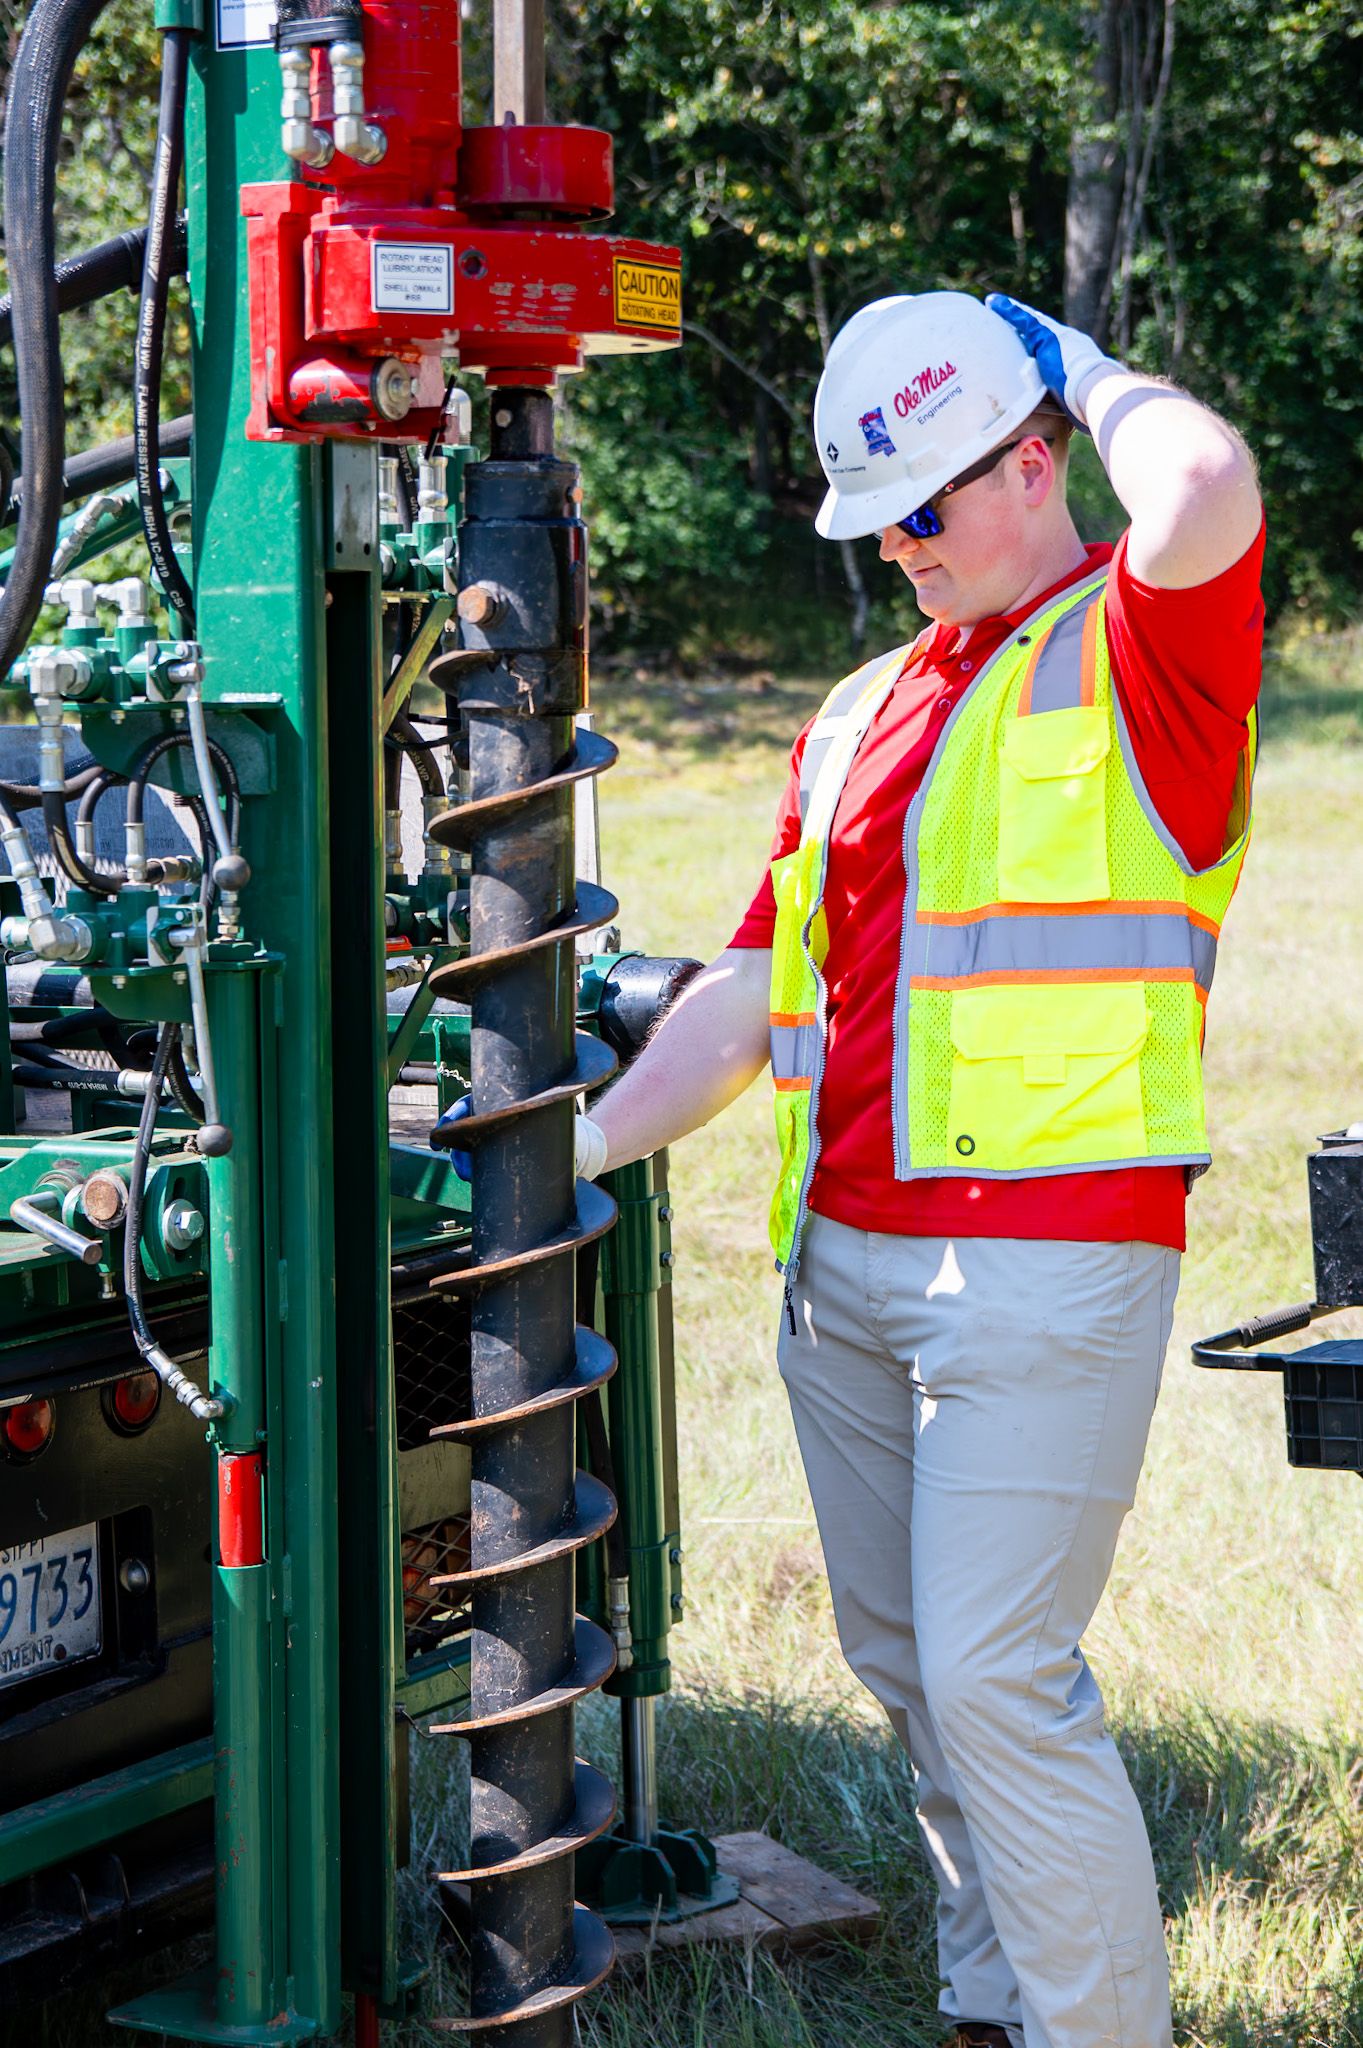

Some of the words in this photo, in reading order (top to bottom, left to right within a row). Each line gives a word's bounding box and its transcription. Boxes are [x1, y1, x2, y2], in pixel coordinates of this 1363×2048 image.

[381, 253, 415, 262] ROTARY
[419, 255, 444, 264] HEAD
[383, 264, 443, 274] LUBRICATION
[383, 283, 409, 292] SHELL
[619, 269, 679, 300] CAUTION
[143, 298, 156, 327] 4000
[622, 303, 656, 320] ROTATING
[657, 308, 677, 322] HEAD
[140, 328, 154, 348] PSI
[140, 348, 152, 370] WP
[894, 386, 922, 418] Ole
[911, 361, 957, 398] Miss
[136, 384, 149, 427] FLAME
[917, 386, 963, 425] Engineering
[137, 428, 151, 496] RESISTANT
[142, 505, 158, 539] MSHA
[0, 1547, 94, 1644] 9733
